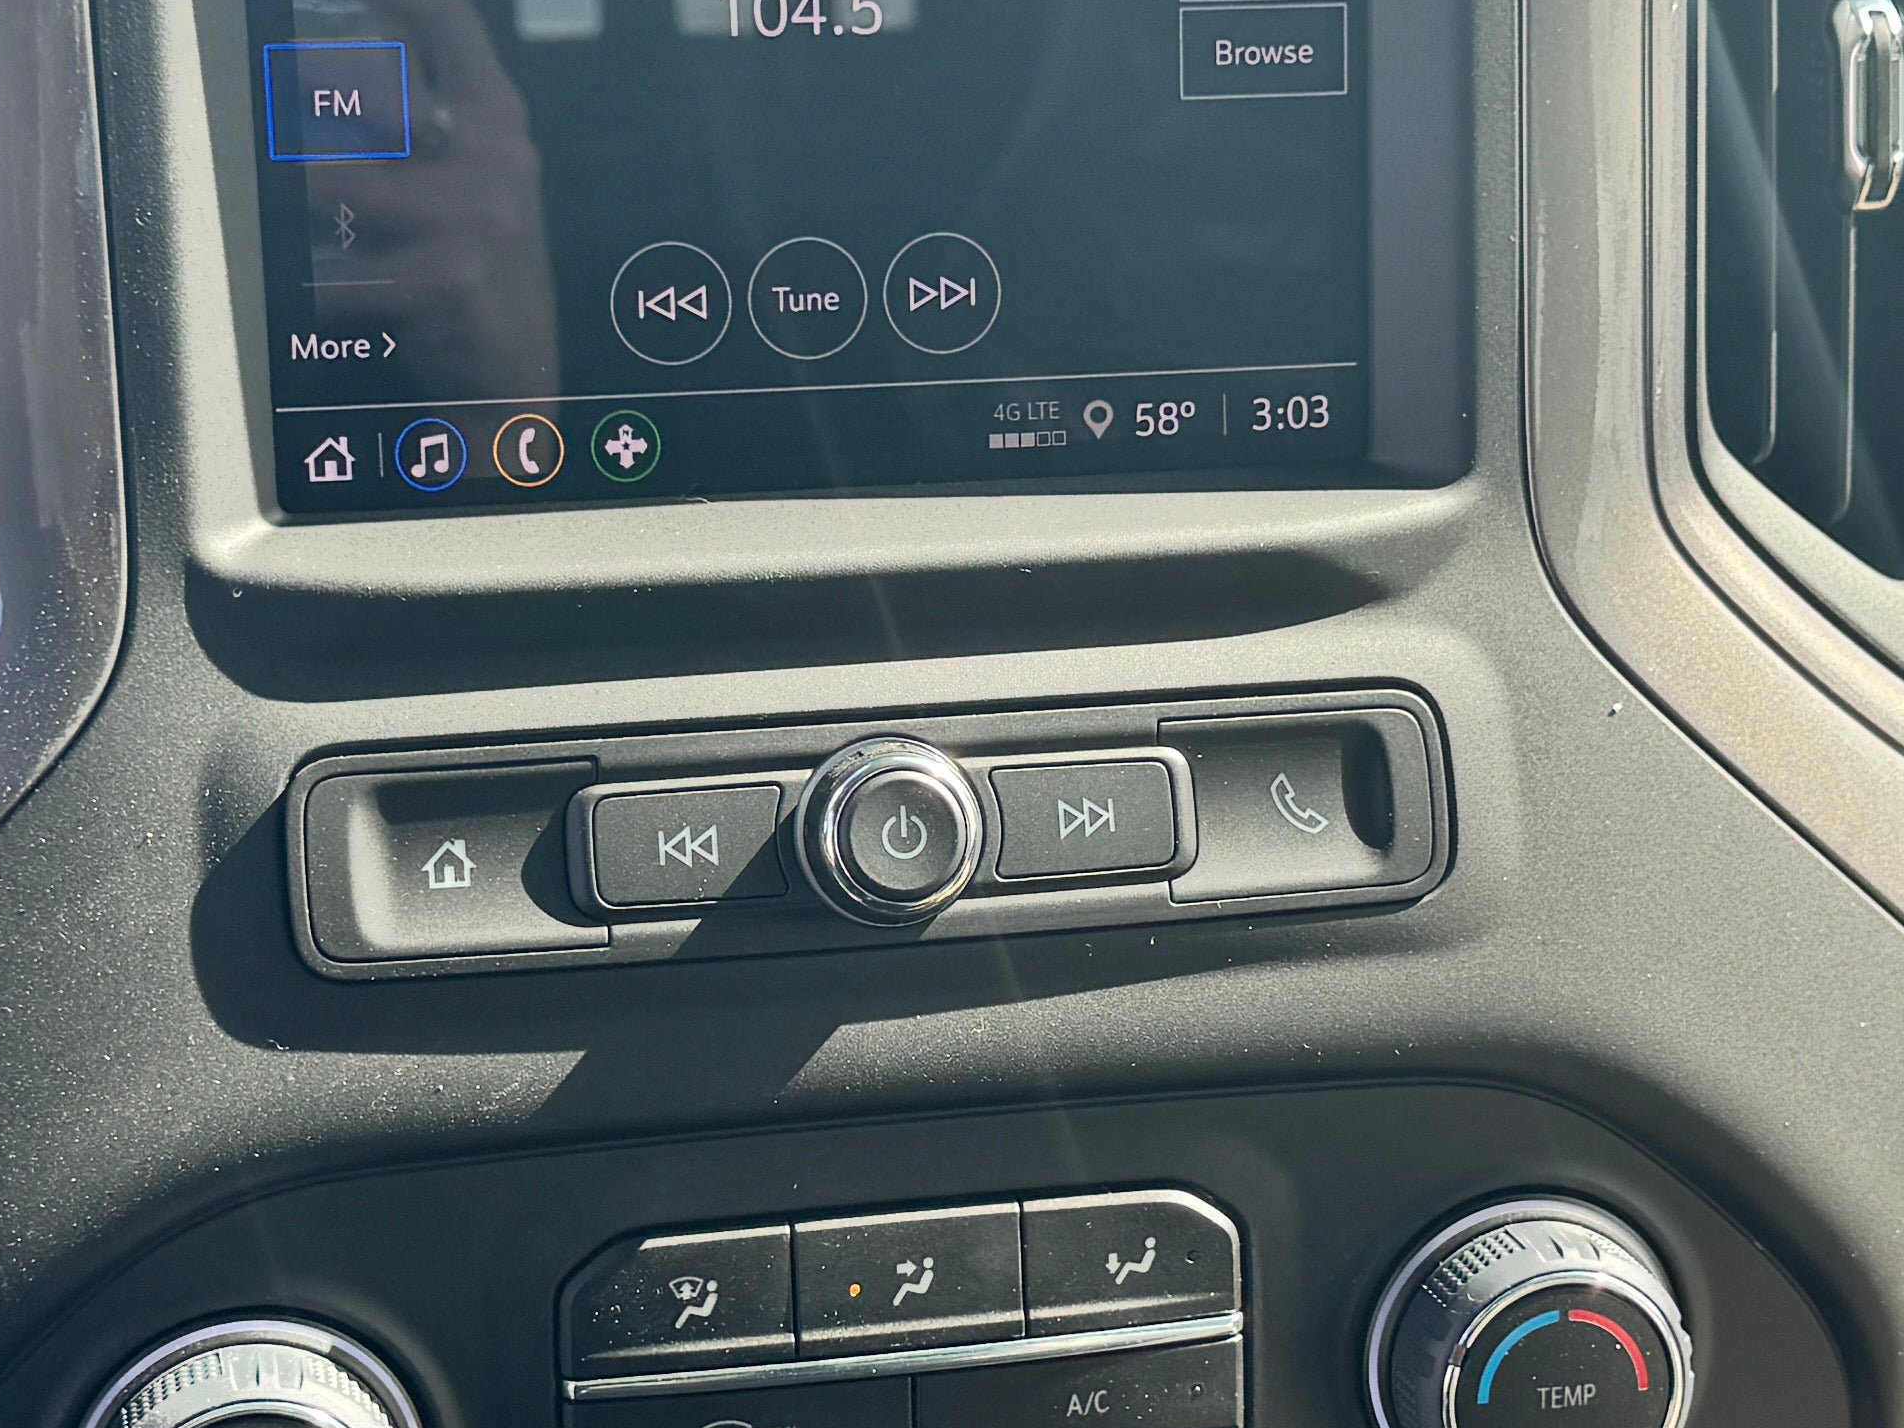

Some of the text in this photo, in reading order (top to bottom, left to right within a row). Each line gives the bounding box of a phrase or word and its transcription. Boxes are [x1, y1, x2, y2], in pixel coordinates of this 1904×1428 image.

[1215, 39, 1314, 66] Browse
[314, 89, 362, 117] FM
[771, 286, 840, 313] Tune
[291, 333, 371, 360] More
[993, 400, 1060, 421] 4G LTE
[1135, 401, 1196, 437] 58°
[1252, 394, 1330, 431] 3:03
[1066, 1389, 1110, 1417] A/C
[1536, 1383, 1596, 1409] TEMP
